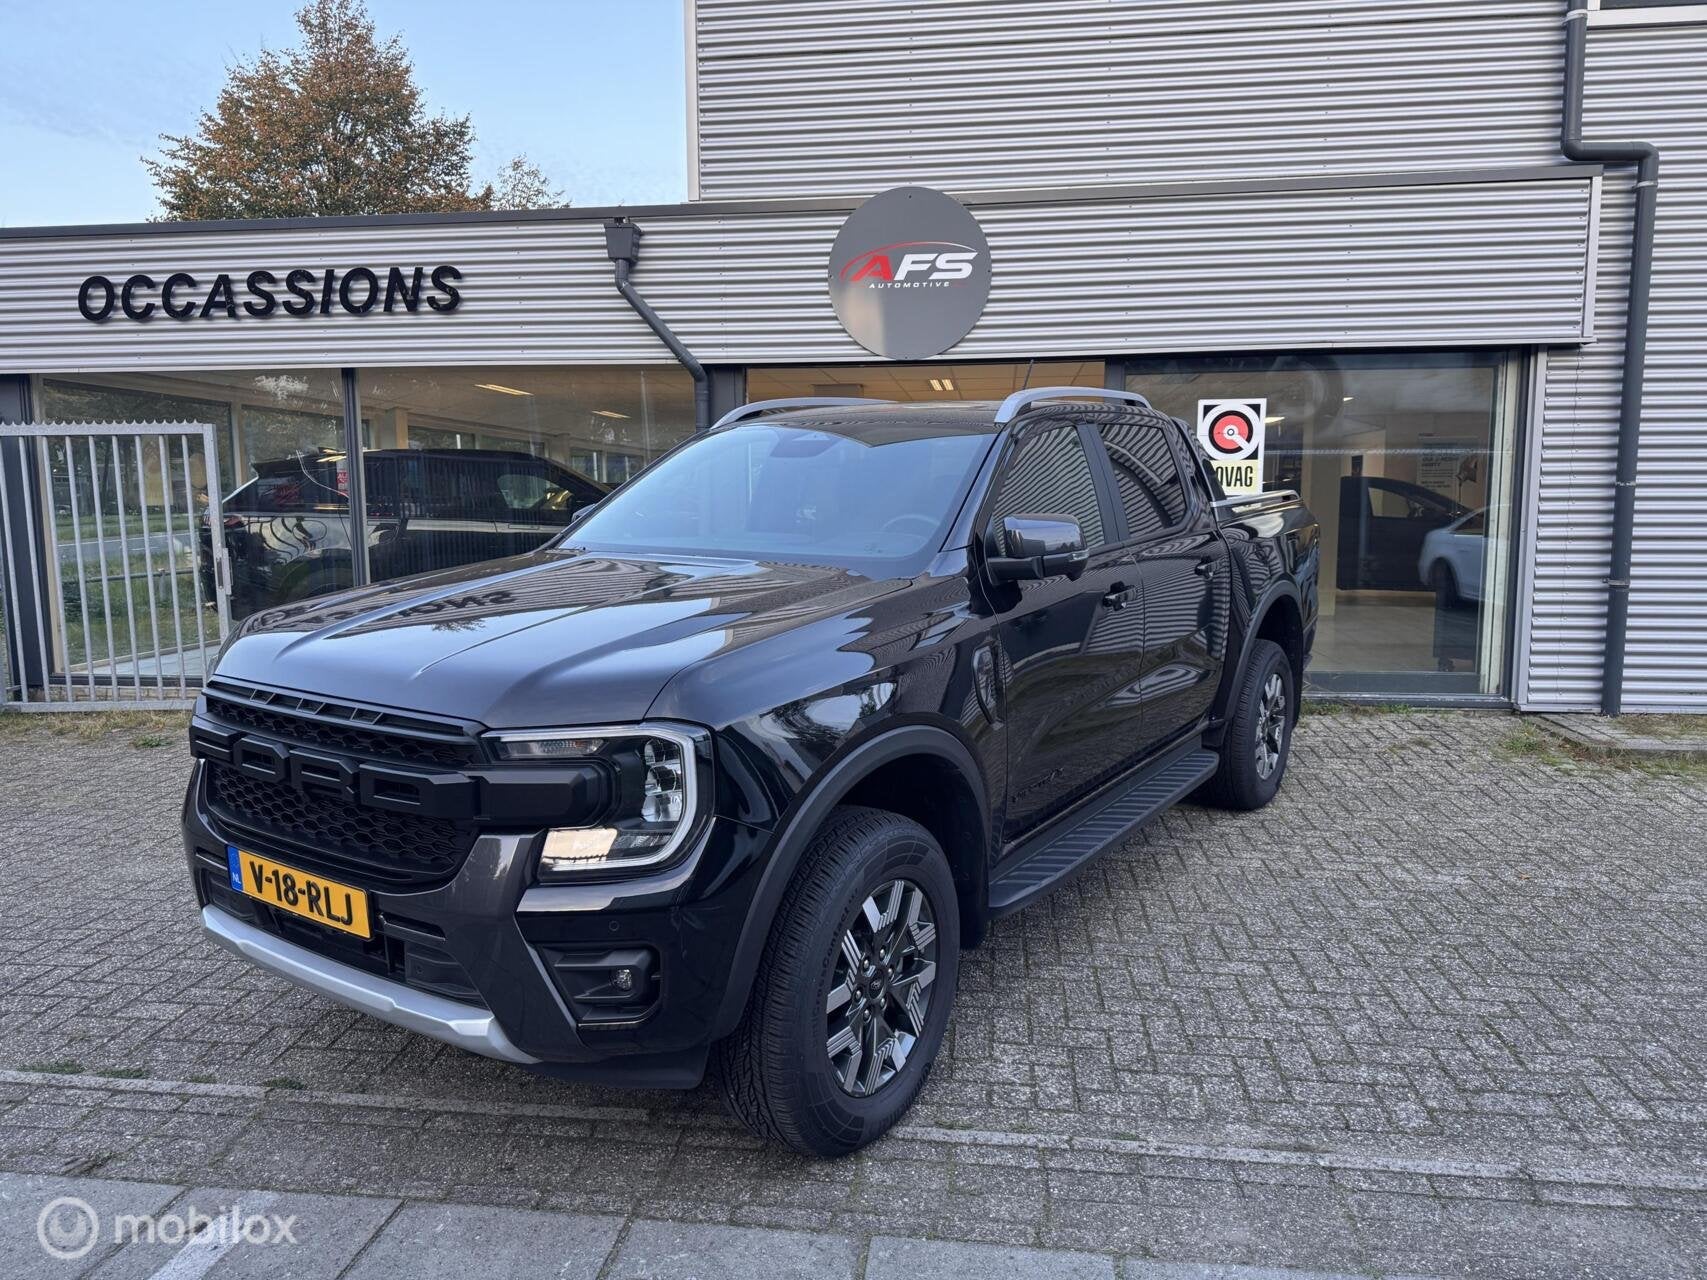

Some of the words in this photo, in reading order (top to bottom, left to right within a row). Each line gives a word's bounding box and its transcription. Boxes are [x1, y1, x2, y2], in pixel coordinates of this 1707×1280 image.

[851, 252, 978, 282] AFS
[77, 264, 463, 321] OCCASSIONS
[869, 281, 950, 289] AUTOMOTIVE
[1216, 466, 1253, 487] OVAG
[189, 714, 477, 819] FORD
[232, 872, 242, 884] NL
[249, 861, 353, 926] V-18-RLJ
